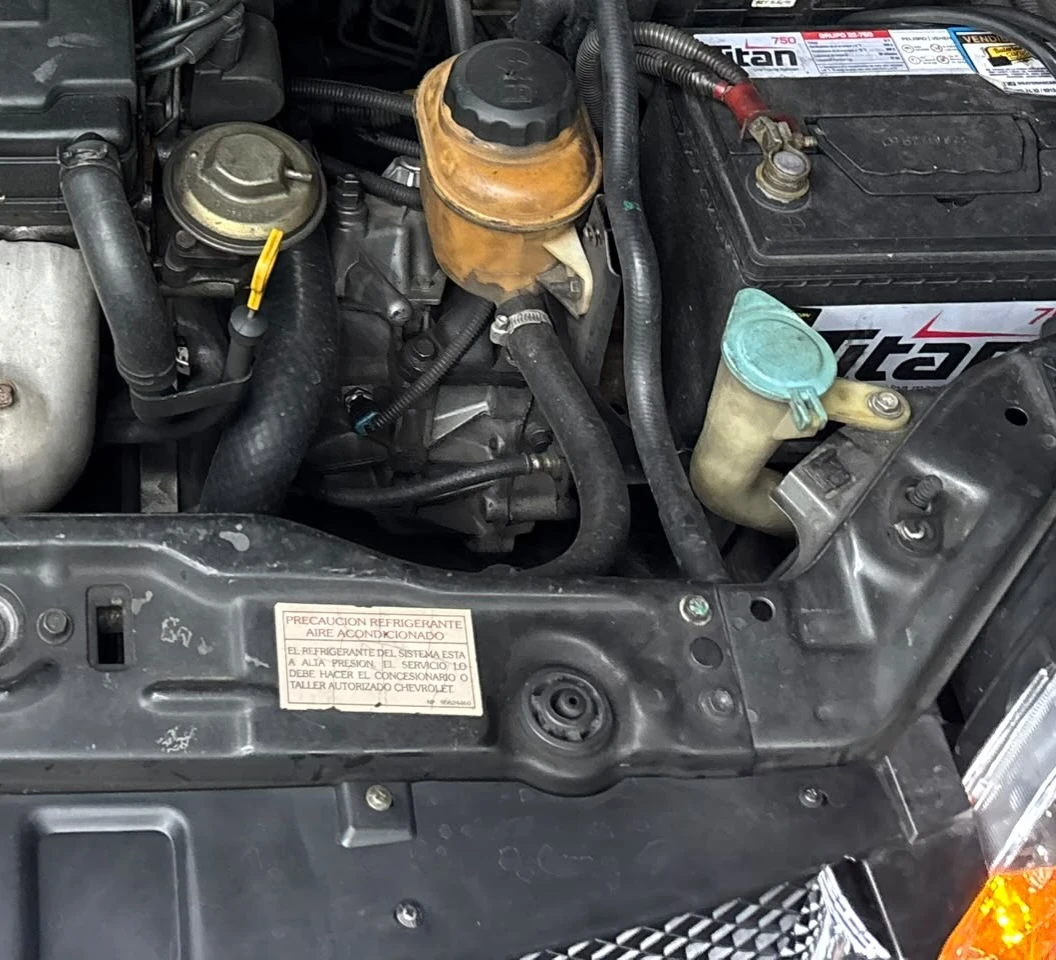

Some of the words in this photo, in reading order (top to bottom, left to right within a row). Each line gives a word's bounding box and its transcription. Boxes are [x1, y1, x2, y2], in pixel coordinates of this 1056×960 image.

[771, 36, 797, 45] 750
[286, 615, 366, 626] PRECAUCION
[369, 617, 463, 629] REFRIGERANTE
[306, 628, 335, 638] AIRE
[336, 629, 445, 641] ACONDICIONADO
[287, 646, 301, 655] EL
[302, 646, 375, 657] REFRIGERANTE
[377, 648, 397, 658] DEL
[398, 649, 440, 659] SISTEMA
[442, 650, 466, 660] ESTA
[287, 658, 296, 666] A
[301, 658, 326, 667] ALTA
[383, 660, 396, 669] EL
[401, 660, 447, 670] SERVICIO
[289, 669, 316, 678] DEBE
[319, 670, 354, 679] HACER
[357, 671, 371, 680] EL
[374, 671, 456, 682] CONCESIONARIO
[460, 673, 469, 683] O
[289, 680, 326, 690] TALLER
[328, 681, 392, 692] AUTORIZADO
